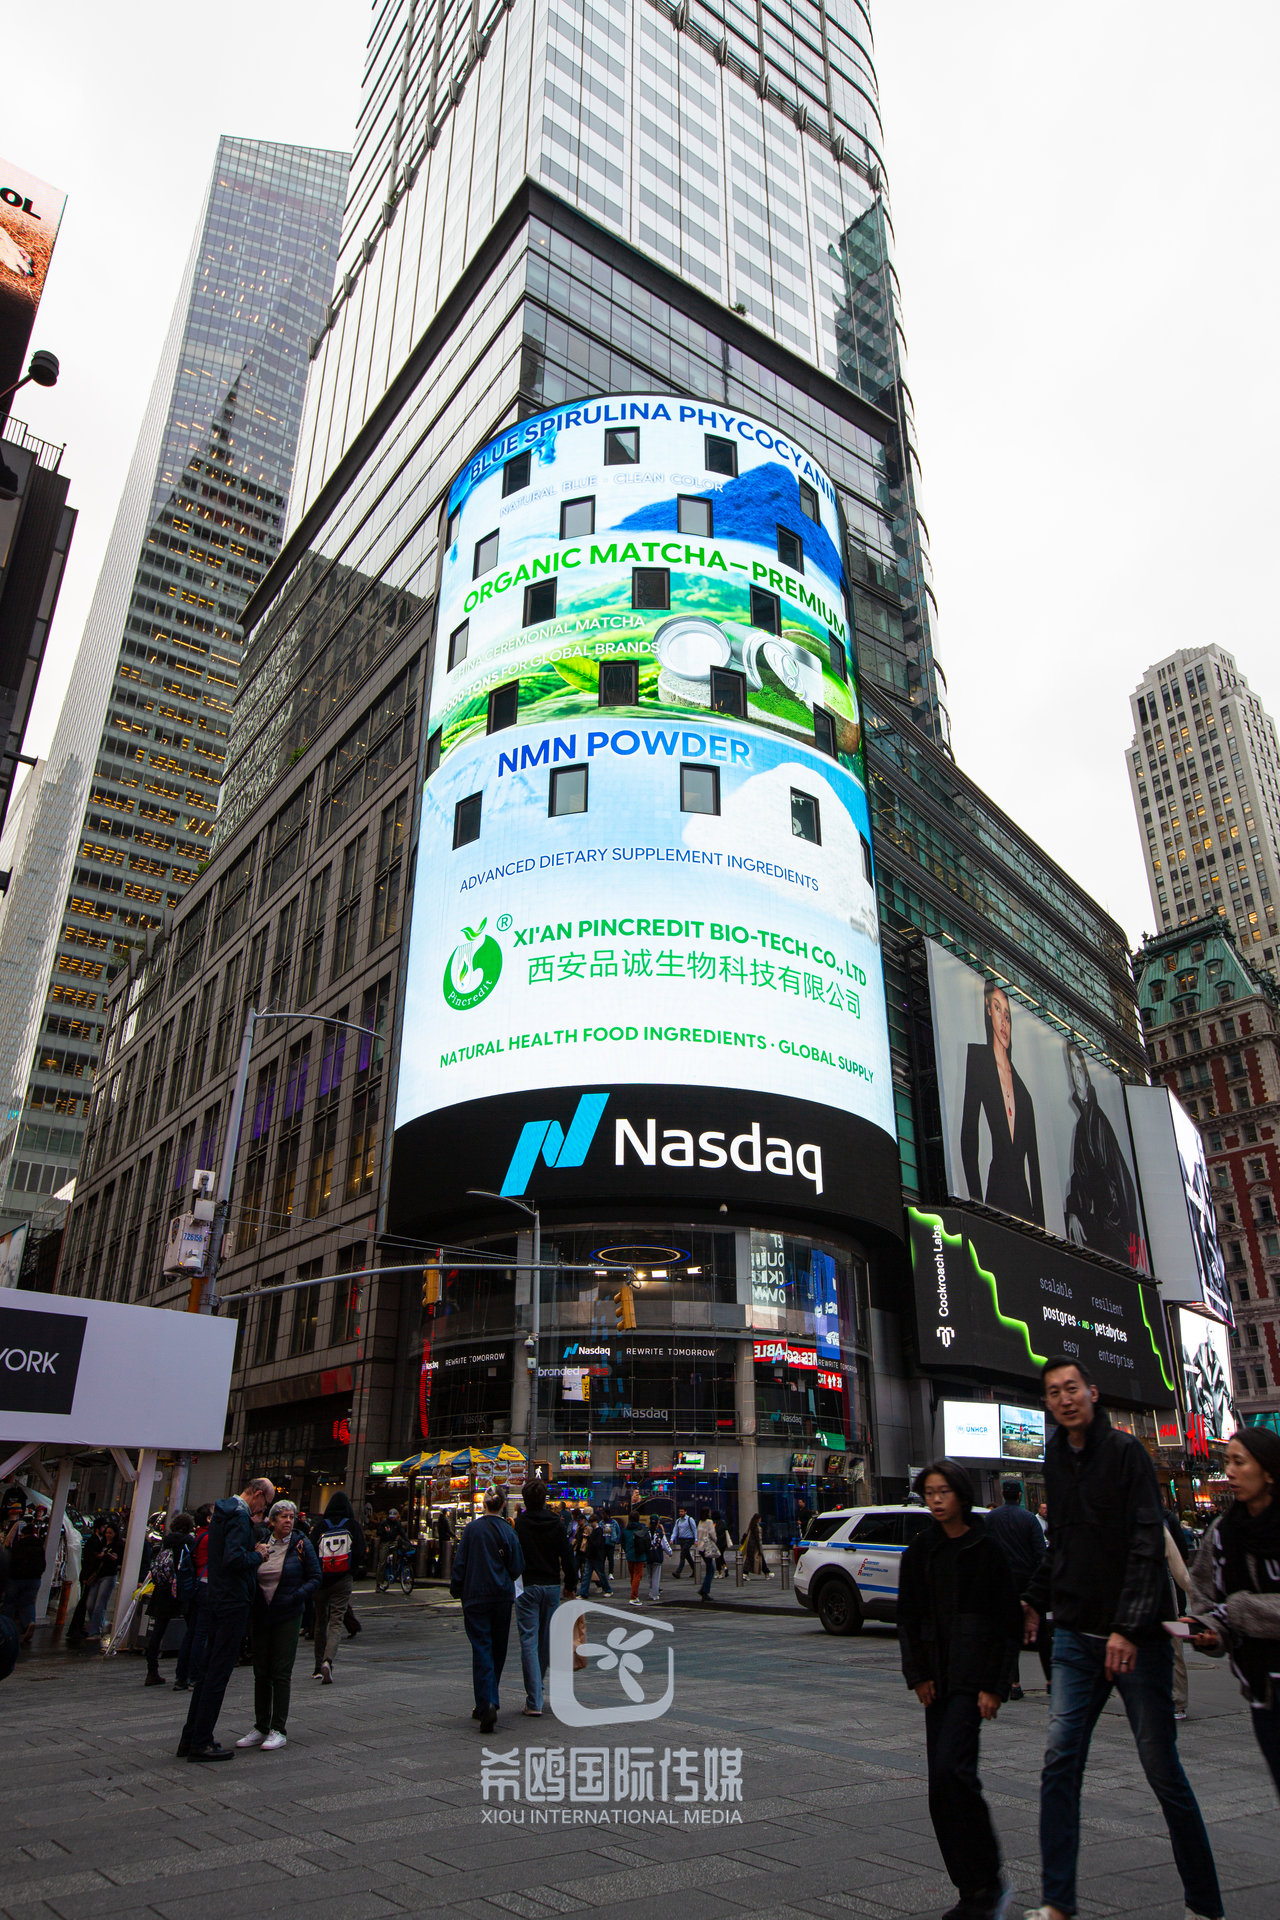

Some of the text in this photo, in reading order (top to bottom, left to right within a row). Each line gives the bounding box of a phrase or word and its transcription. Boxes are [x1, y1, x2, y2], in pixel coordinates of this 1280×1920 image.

[469, 435, 519, 483] BLUE
[524, 402, 672, 442] SPIRULINA
[499, 472, 723, 517] NATURAL BLUE CLEAN COLOR
[463, 548, 582, 613] ORGANIC
[485, 624, 571, 662] CEREMONIAL
[575, 615, 645, 631] MATCHA
[500, 659, 532, 682] FOR
[531, 645, 592, 668] GLOBAL
[595, 641, 660, 654] BRANDS
[498, 729, 751, 778] NMN POWDER
[459, 847, 819, 893] ADVANCED DIETARY SUPPLEMENT INGREDIENTS
[512, 921, 573, 948] XI'AN
[579, 918, 704, 939] PINCREDIT
[710, 923, 808, 958] BIO-TECH
[448, 980, 492, 1006] Pincredit
[528, 948, 862, 1020] 西安品诚生物科技有限公司
[439, 1026, 874, 1084] NATURAL HEALTH FOOD INGREDIENTS GLOBAL SUPPLY
[614, 1118, 823, 1196] Nasdaq
[933, 1224, 949, 1317] Cockroach Labs
[1039, 1278, 1072, 1299] scalable
[1043, 1305, 1077, 1326] postgres
[1094, 1322, 1128, 1342] petabytes
[1091, 1297, 1124, 1317] resilient
[469, 1353, 506, 1363] TOMORROW
[578, 1346, 716, 1357] Nasdaq REWRITE TOMORROW
[1063, 1340, 1080, 1358] easy
[1098, 1350, 1134, 1369] enterprise
[623, 1407, 668, 1422] Nasdaq
